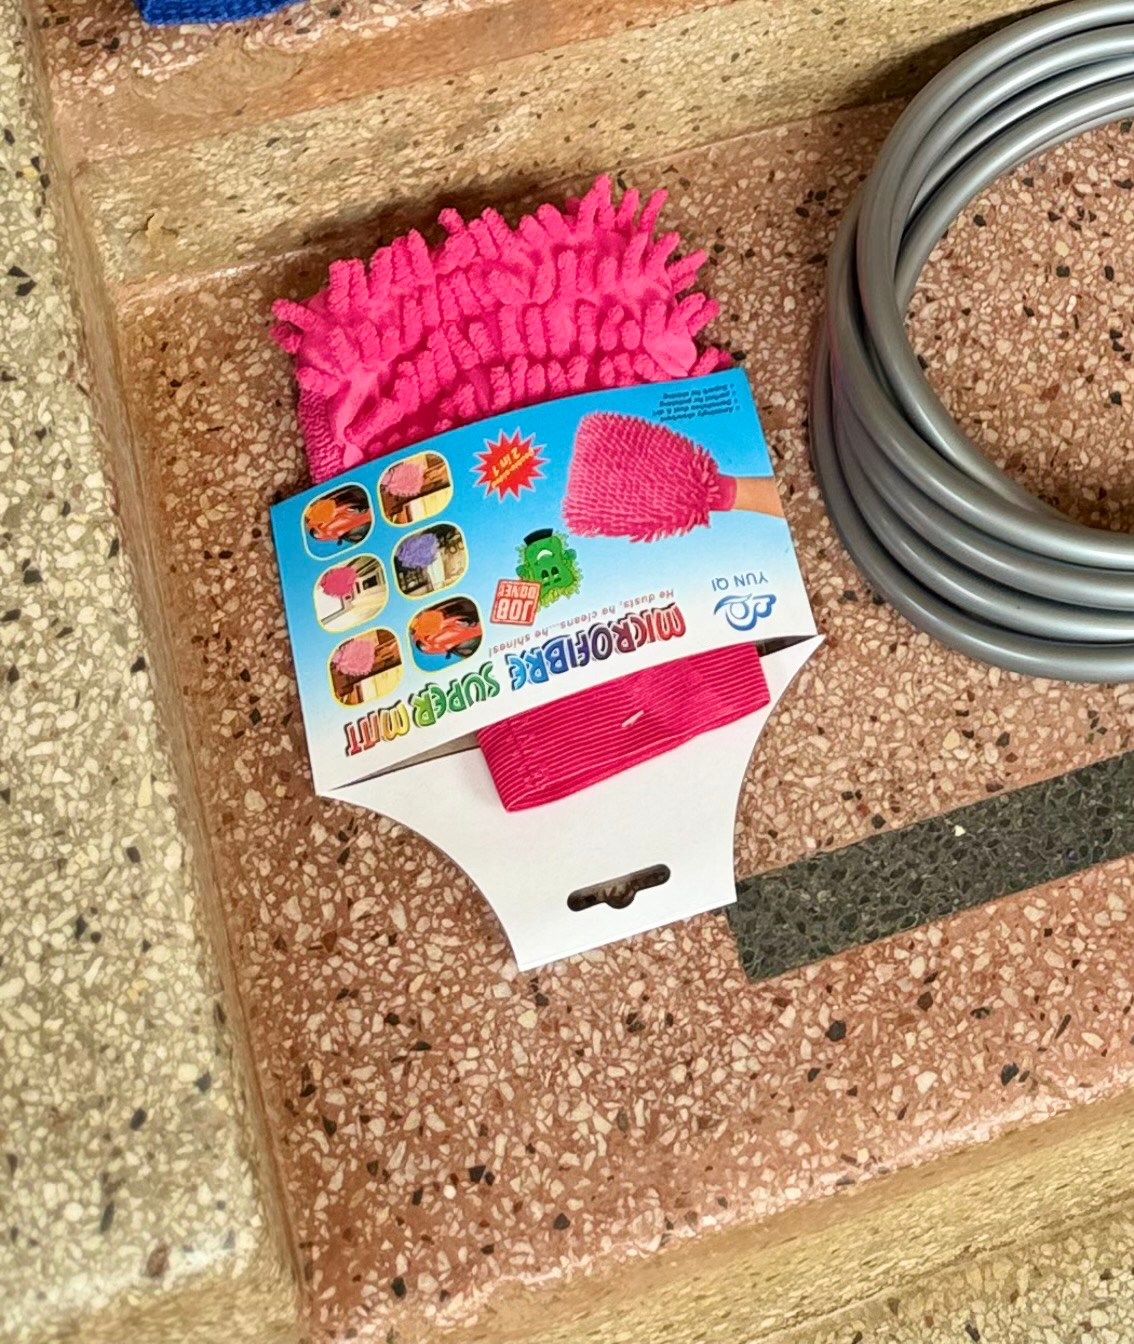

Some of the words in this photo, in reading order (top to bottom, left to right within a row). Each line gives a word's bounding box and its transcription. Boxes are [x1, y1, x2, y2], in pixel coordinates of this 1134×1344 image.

[500, 454, 512, 468] in
[511, 447, 521, 460] 2
[492, 465, 500, 477] 1
[711, 577, 729, 592] QI
[733, 571, 769, 588] YUN
[619, 593, 656, 609] dusts,
[659, 589, 675, 599] He
[497, 598, 533, 623] JOB
[601, 605, 616, 615] he
[488, 634, 531, 658] shines!
[505, 602, 686, 691] MICROFIBRE
[408, 661, 501, 728] SUPER
[344, 699, 411, 757] MITT
